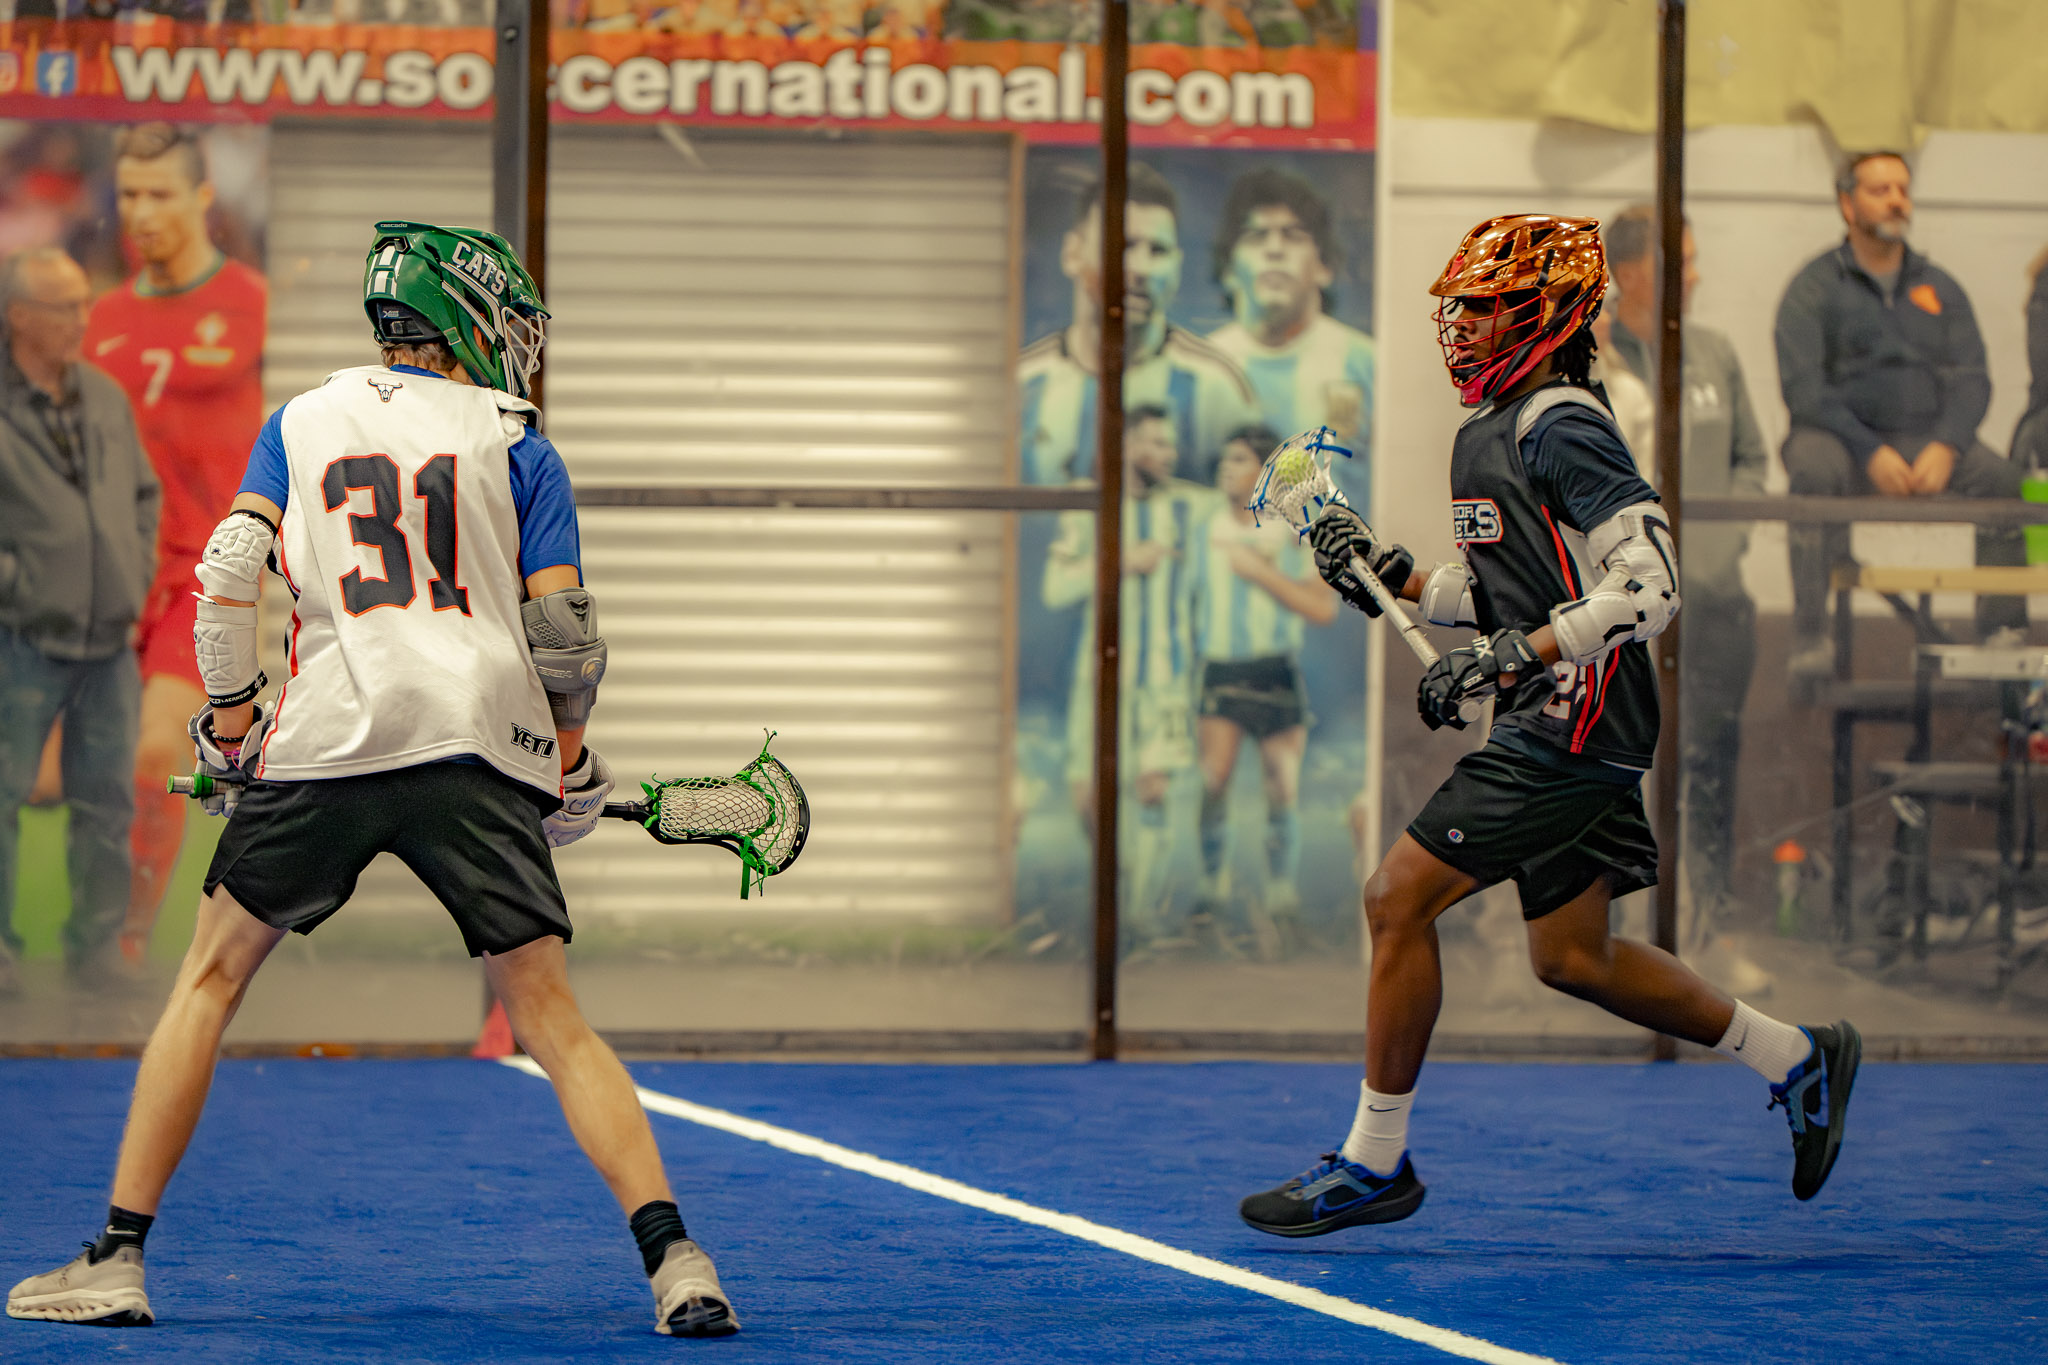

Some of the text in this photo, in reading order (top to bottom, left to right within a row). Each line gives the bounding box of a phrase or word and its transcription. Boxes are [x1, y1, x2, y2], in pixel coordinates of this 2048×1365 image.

[111, 43, 1315, 130] www.socernational.com
[451, 241, 507, 296] CATS
[140, 348, 174, 407] 7
[320, 453, 473, 618] 31
[1455, 503, 1499, 538] ELS
[1472, 635, 1495, 660] TX
[1463, 672, 1485, 690] STX
[510, 722, 557, 759] YETI
